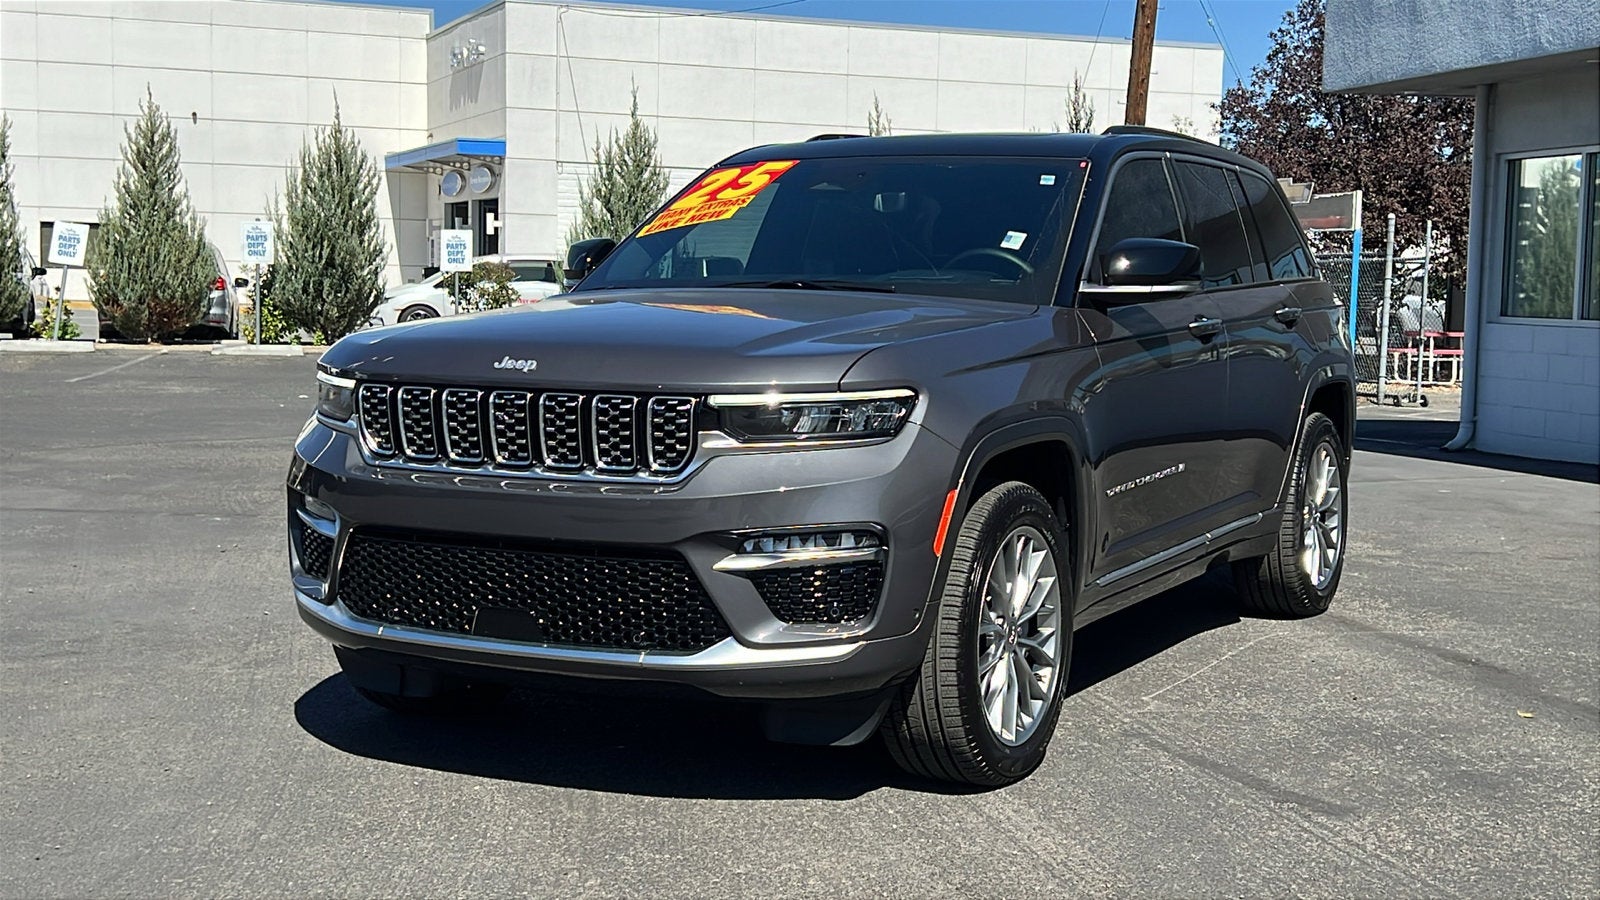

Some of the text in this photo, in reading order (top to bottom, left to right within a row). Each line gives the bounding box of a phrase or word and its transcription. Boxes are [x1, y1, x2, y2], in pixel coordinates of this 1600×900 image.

[669, 161, 796, 210] 25
[657, 197, 751, 221] MANY EXTRAS
[644, 208, 730, 233] LIKE NEW
[58, 235, 80, 244] PARTS
[246, 234, 268, 242] PARTS
[493, 355, 538, 373] Jeep
